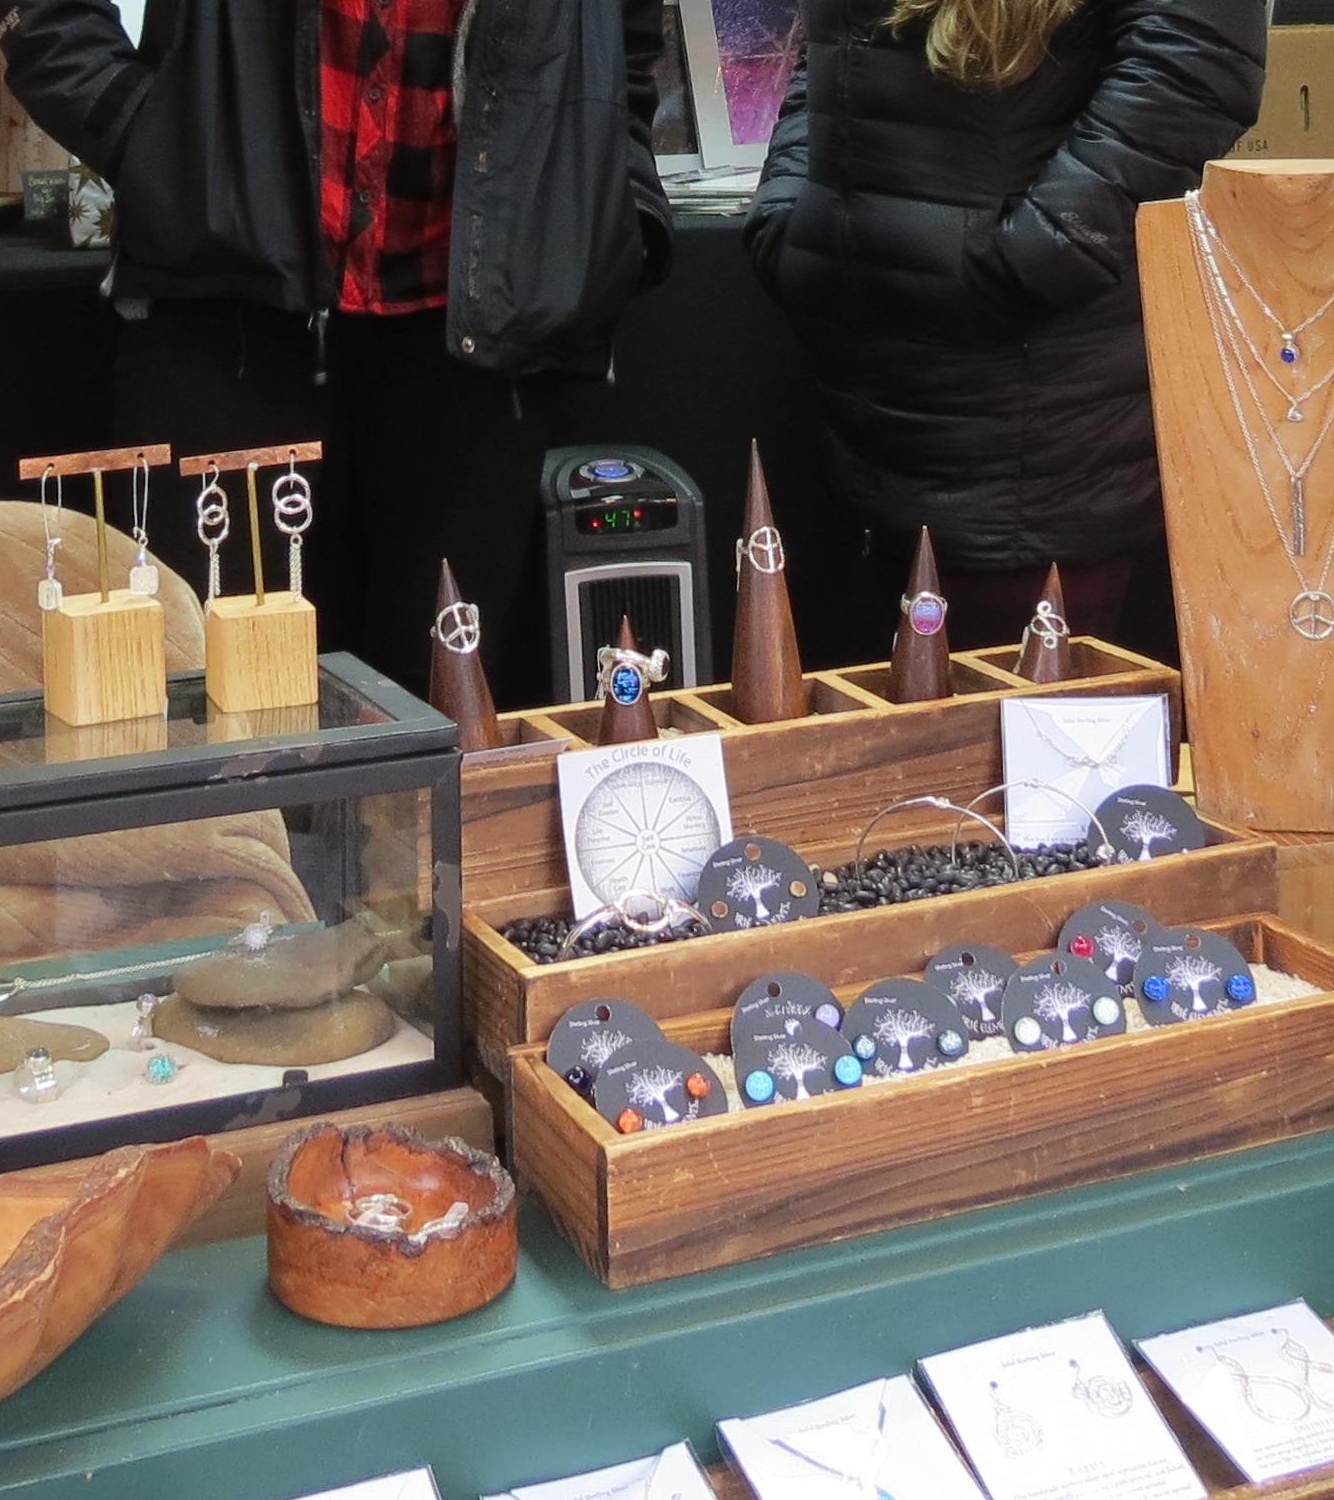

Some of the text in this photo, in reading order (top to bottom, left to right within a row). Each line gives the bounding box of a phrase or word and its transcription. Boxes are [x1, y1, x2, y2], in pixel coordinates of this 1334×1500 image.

[1247, 139, 1269, 153] USA
[604, 509, 630, 528] 47
[584, 744, 692, 779] The Circle of Life
